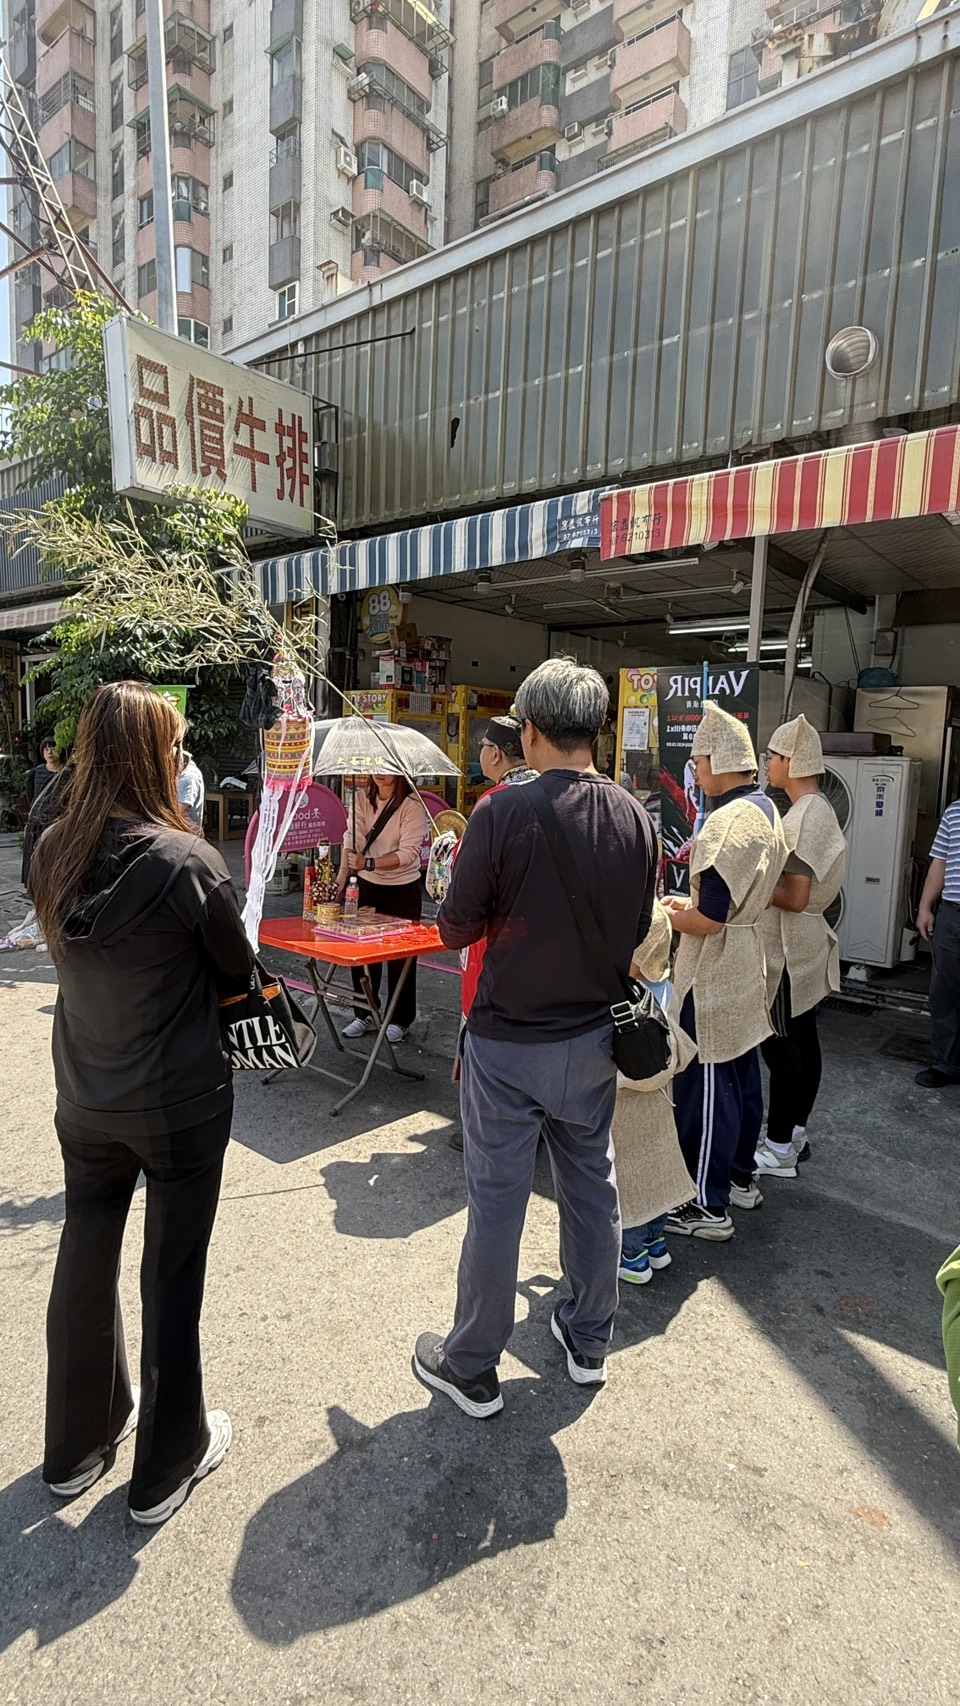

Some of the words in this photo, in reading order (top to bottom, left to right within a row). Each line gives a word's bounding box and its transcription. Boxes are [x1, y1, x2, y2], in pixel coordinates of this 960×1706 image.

[133, 353, 310, 508] 品價牛排
[621, 527, 661, 543] 6210313
[368, 589, 391, 616] 88
[630, 673, 657, 692] TO
[362, 692, 387, 703] STORY
[293, 809, 311, 821] ood
[227, 1015, 286, 1049] NTLE
